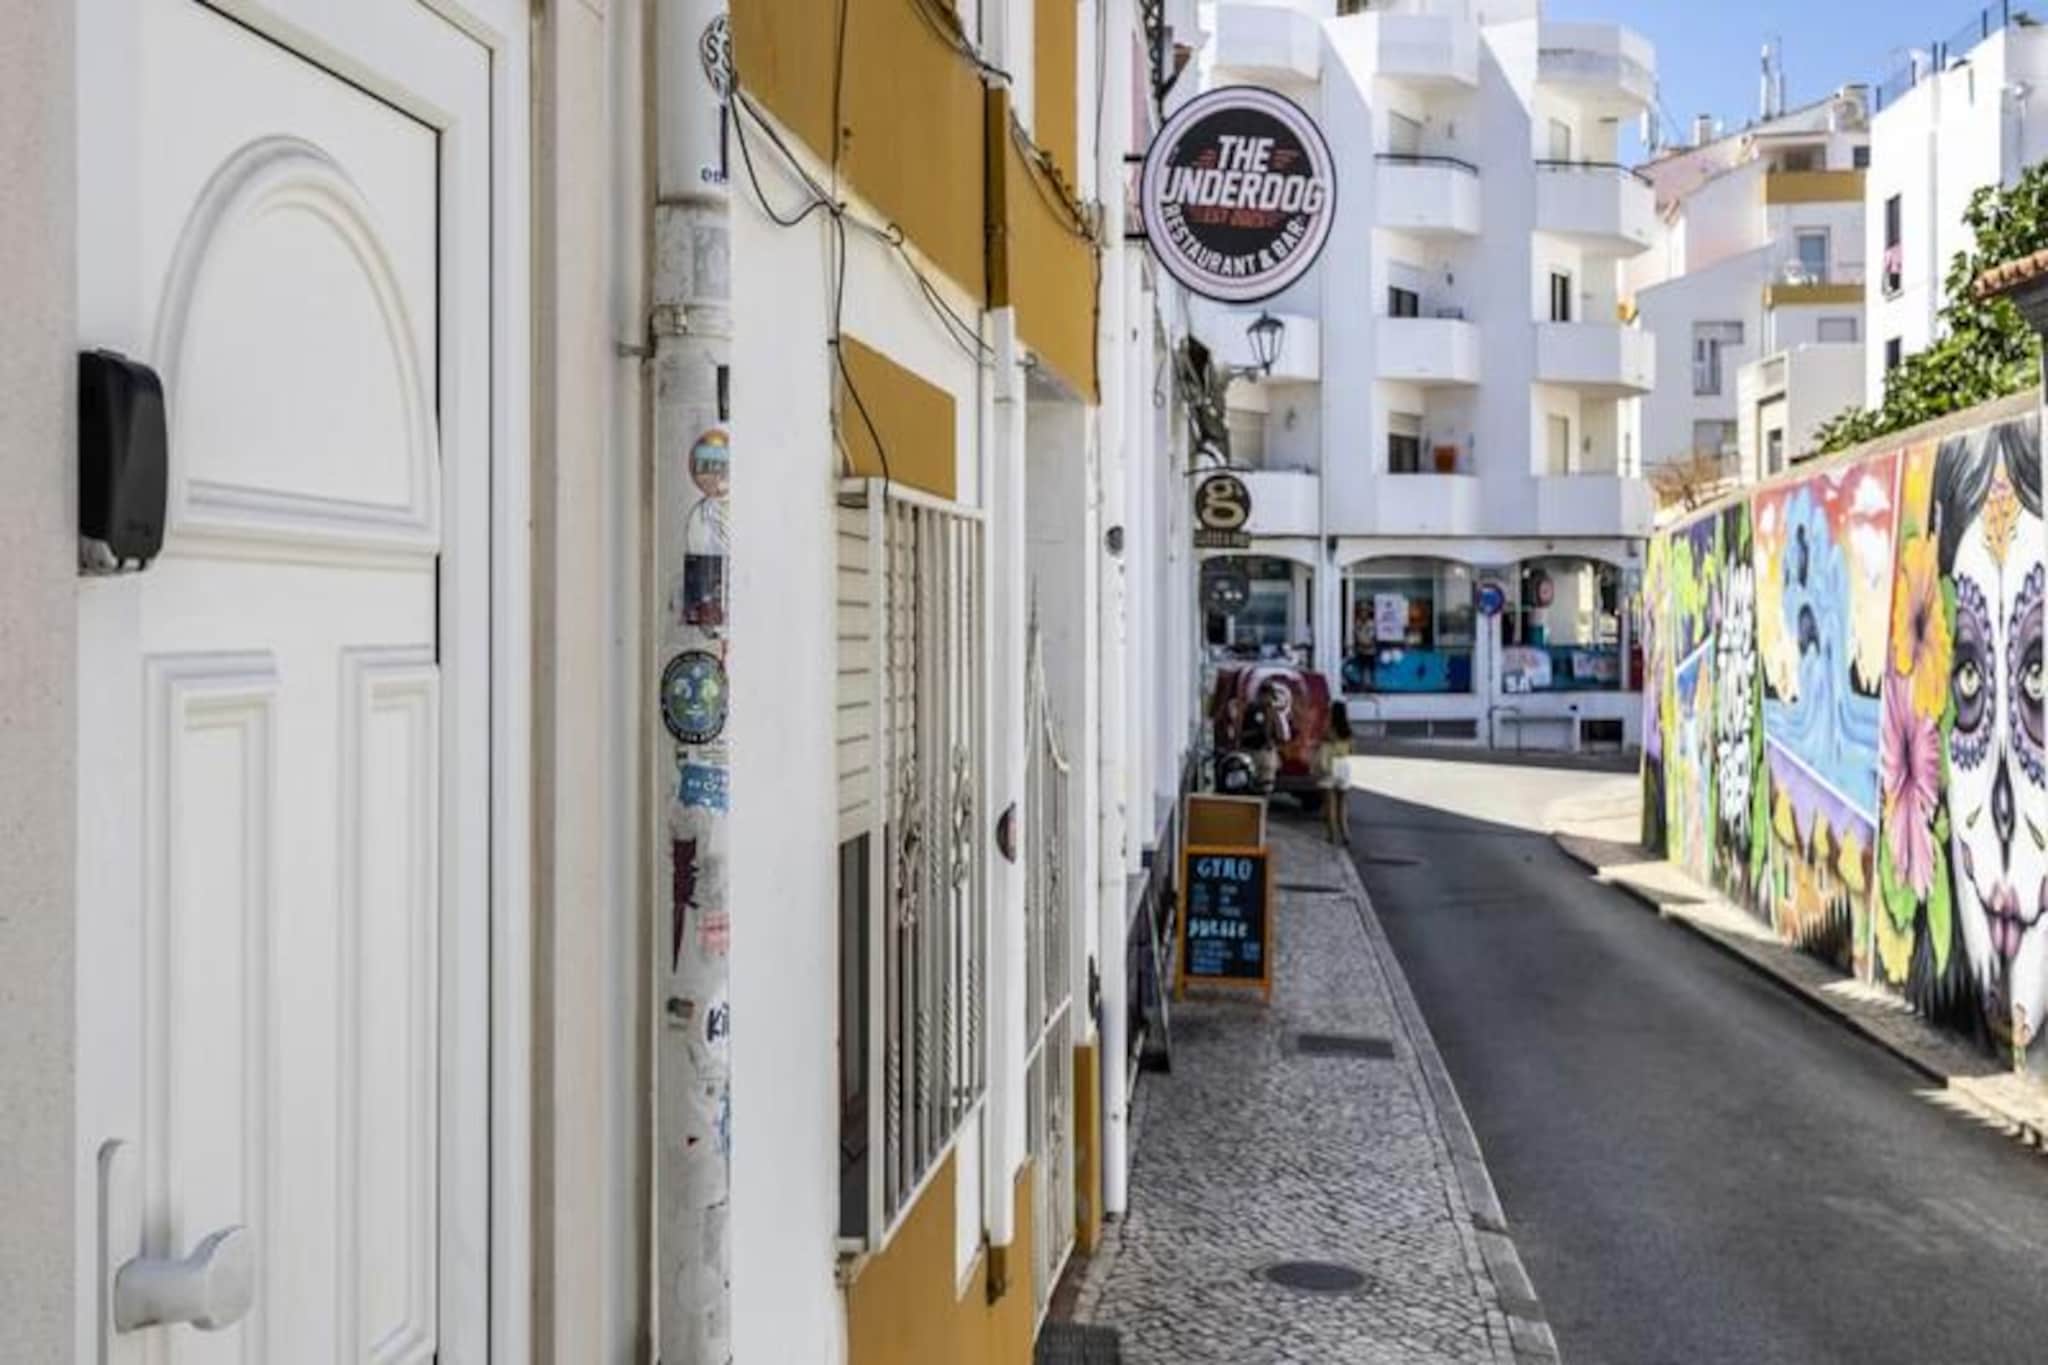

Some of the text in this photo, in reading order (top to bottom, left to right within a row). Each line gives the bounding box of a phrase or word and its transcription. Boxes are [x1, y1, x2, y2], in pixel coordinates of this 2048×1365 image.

[1216, 135, 1276, 171] THE
[1160, 165, 1326, 214] UNDERDOG
[1162, 202, 1257, 277] RESTAURANT
[1260, 249, 1274, 270] &
[1271, 221, 1306, 260] BAR
